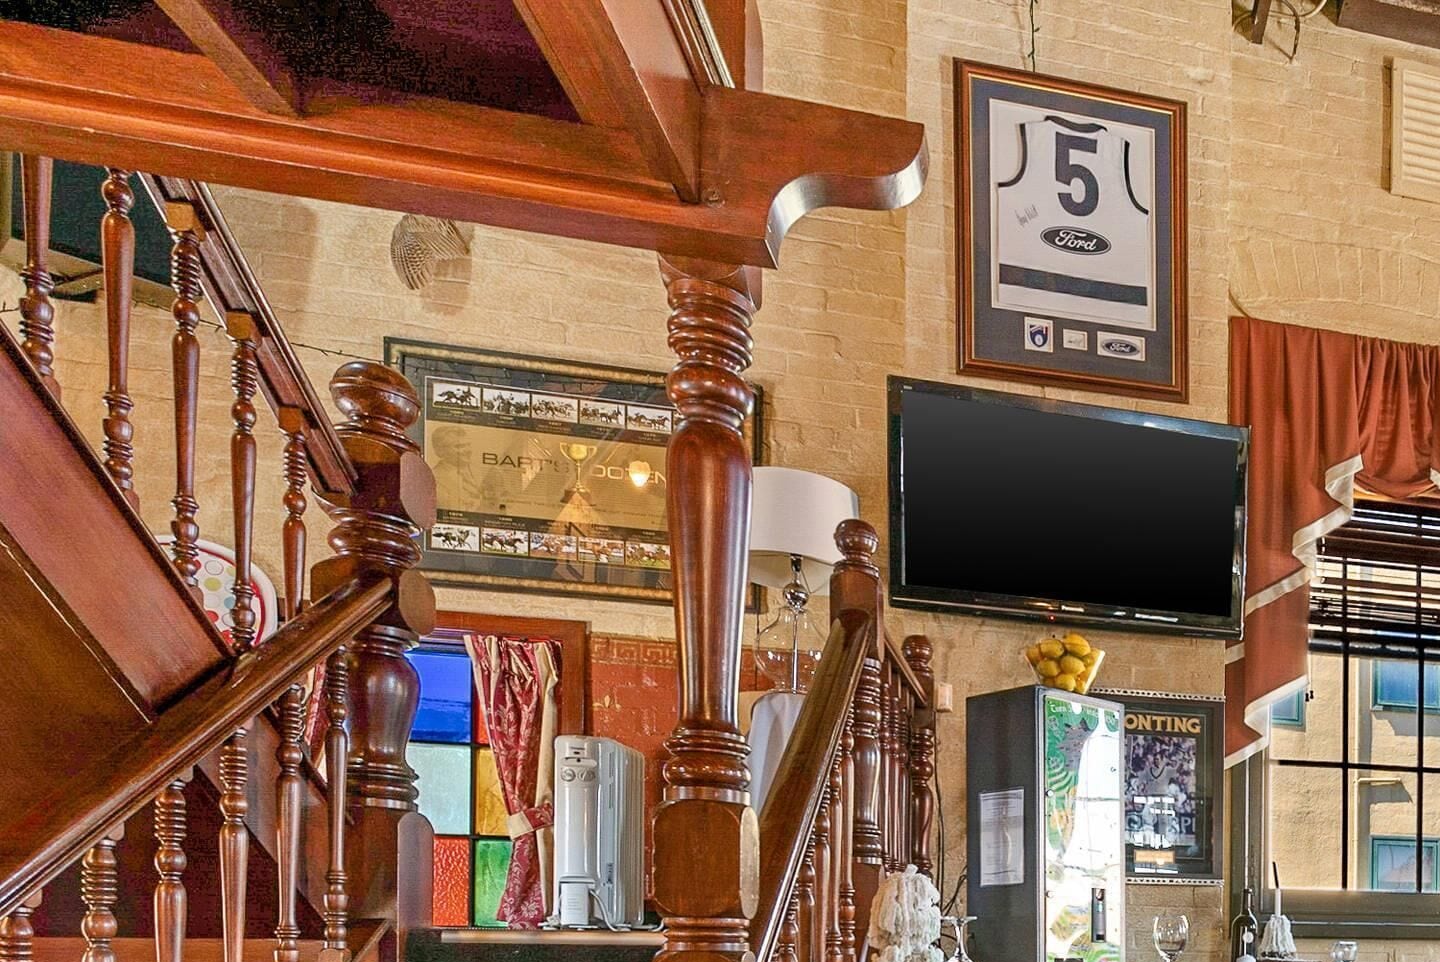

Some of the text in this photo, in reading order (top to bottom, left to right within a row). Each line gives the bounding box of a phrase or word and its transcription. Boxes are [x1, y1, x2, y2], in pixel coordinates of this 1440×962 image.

[1055, 131, 1100, 217] 5
[1054, 229, 1097, 252] Ford
[591, 464, 667, 489] DOEN
[1124, 713, 1202, 733] ONTING
